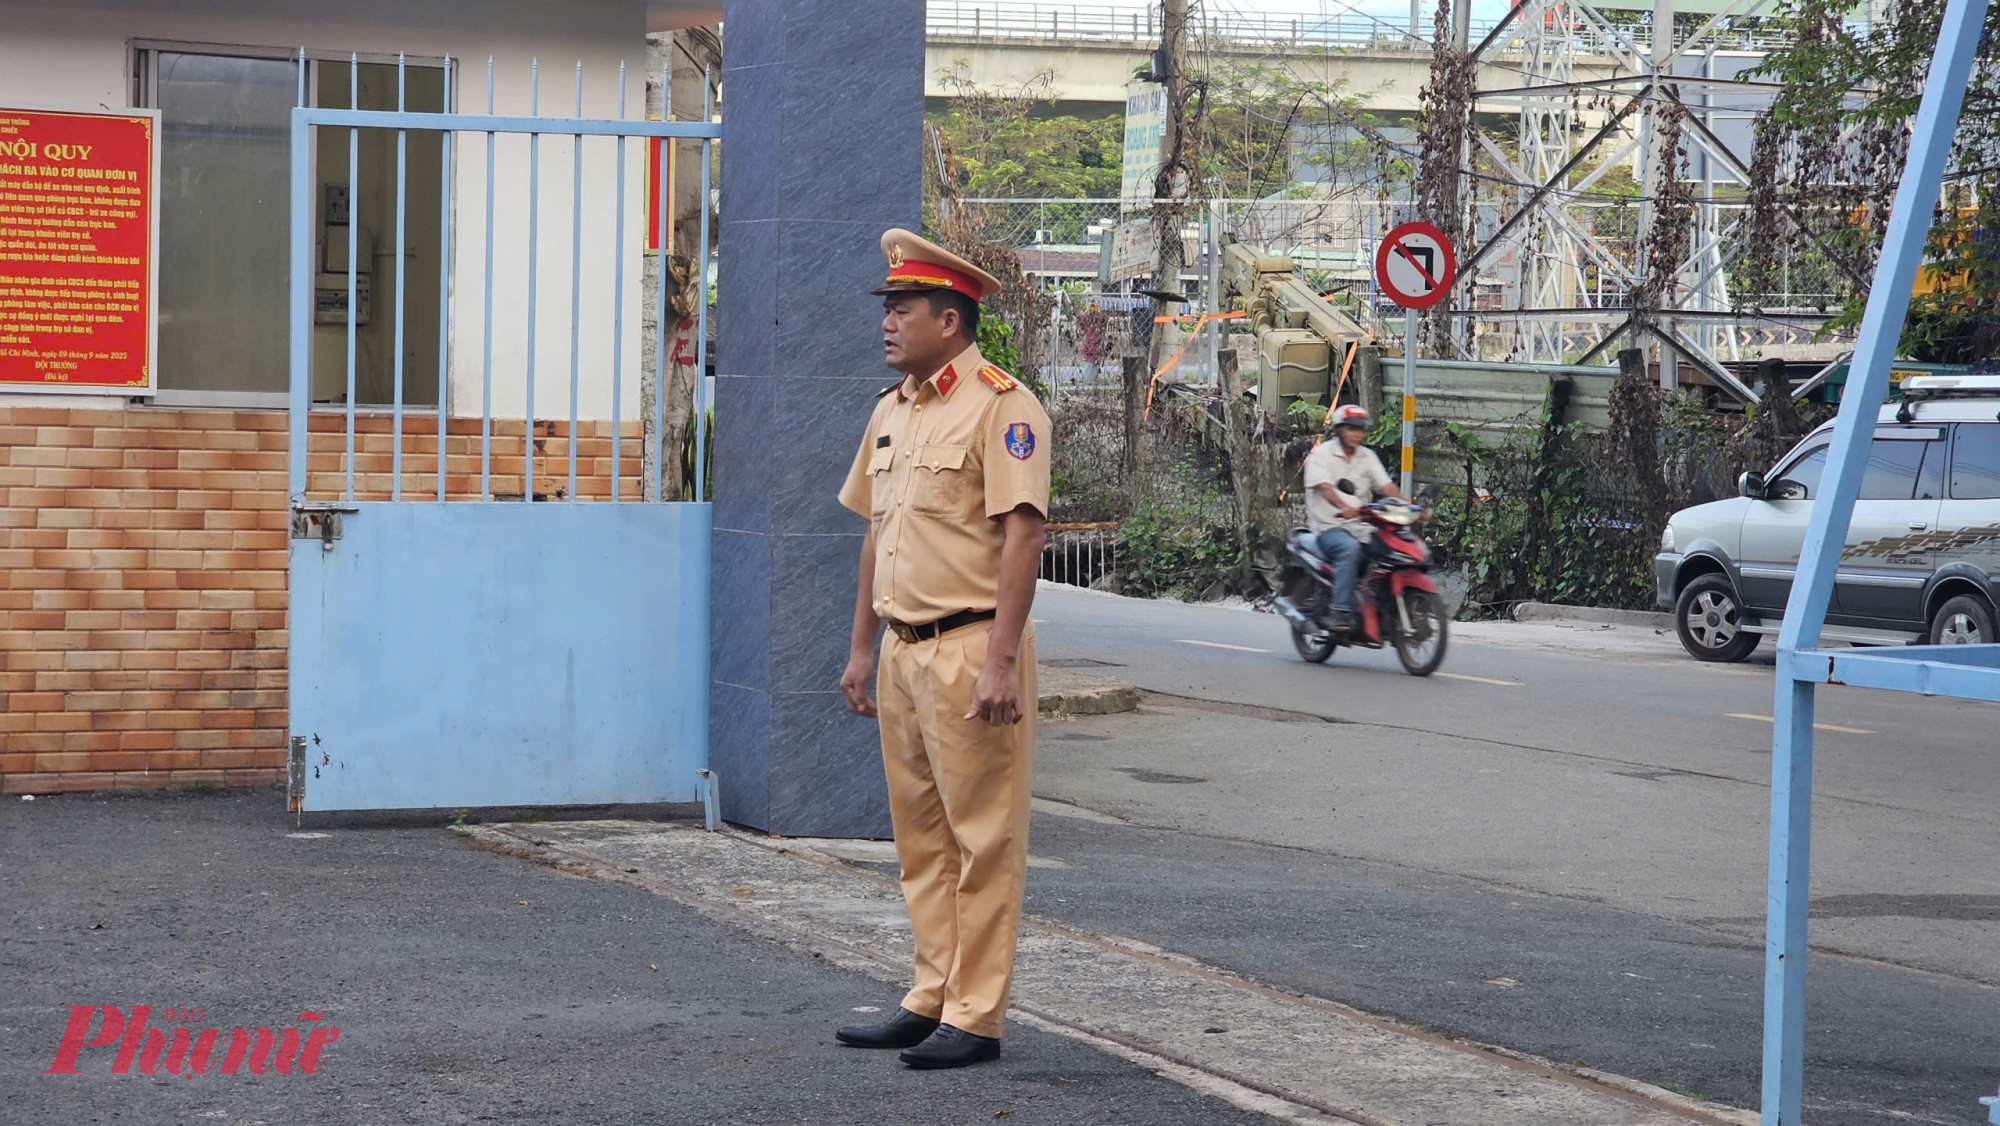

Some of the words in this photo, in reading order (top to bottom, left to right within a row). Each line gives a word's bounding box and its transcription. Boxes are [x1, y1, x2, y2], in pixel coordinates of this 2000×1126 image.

[0, 138, 37, 161] NỘI
[44, 144, 92, 161] QUY
[24, 165, 37, 176] RA
[40, 164, 58, 176] VÀO
[61, 166, 75, 178] CƠ
[77, 168, 103, 180] QUAN
[105, 169, 126, 180] ĐƠN
[128, 170, 137, 182] VỊ
